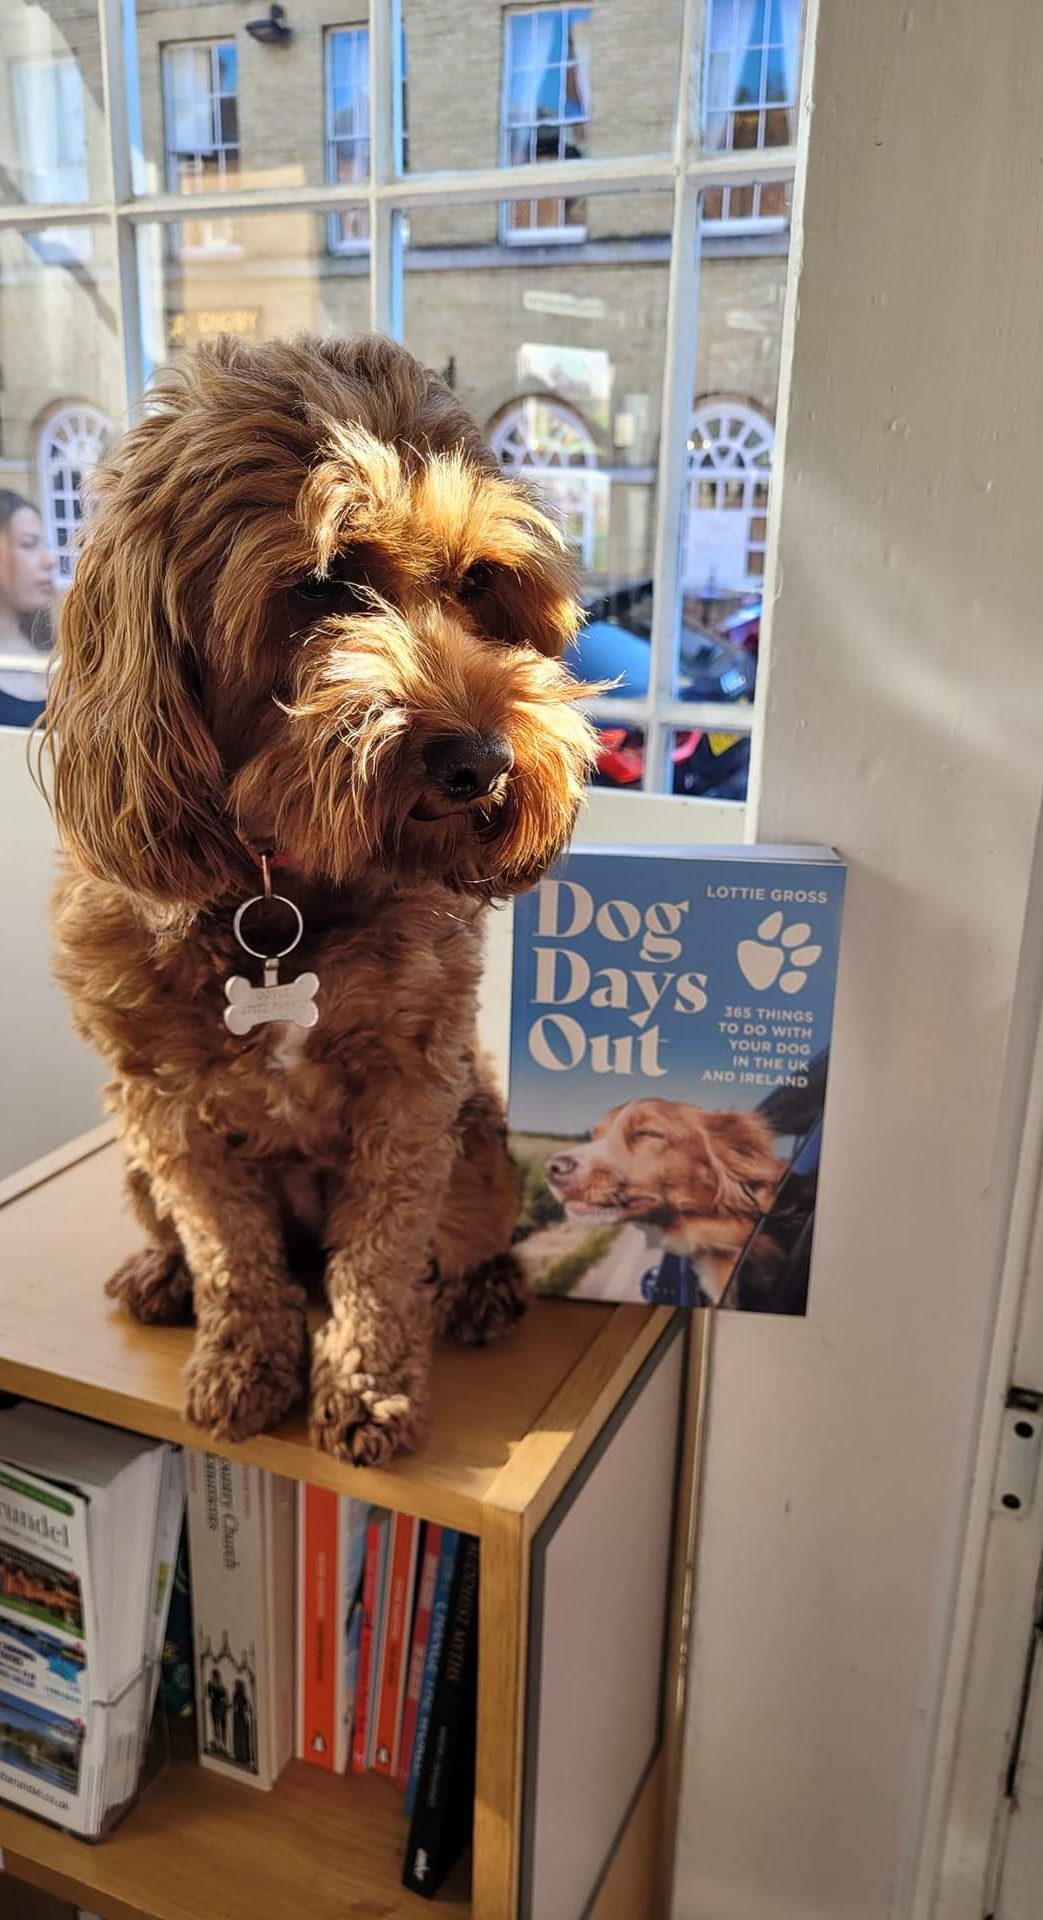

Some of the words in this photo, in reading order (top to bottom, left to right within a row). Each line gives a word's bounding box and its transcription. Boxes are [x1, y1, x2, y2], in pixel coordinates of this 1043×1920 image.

[706, 885, 766, 900] LOTTIE
[770, 889, 828, 904] GROSS
[532, 879, 690, 963] Dog
[530, 946, 708, 1028] Days
[724, 1006, 751, 1019] 365
[756, 1008, 813, 1022] THINGS
[718, 1022, 739, 1035] TO
[743, 1025, 767, 1036] DO
[771, 1026, 812, 1038] WITH
[528, 1013, 670, 1077] Out
[729, 1039, 771, 1052] YOUR
[776, 1042, 811, 1055] DOG
[733, 1056, 749, 1067] IN
[754, 1057, 784, 1070] THE
[788, 1060, 809, 1072] UK
[702, 1070, 735, 1082] AND
[740, 1072, 809, 1088] IRELAND
[221, 1512, 241, 1571] Church
